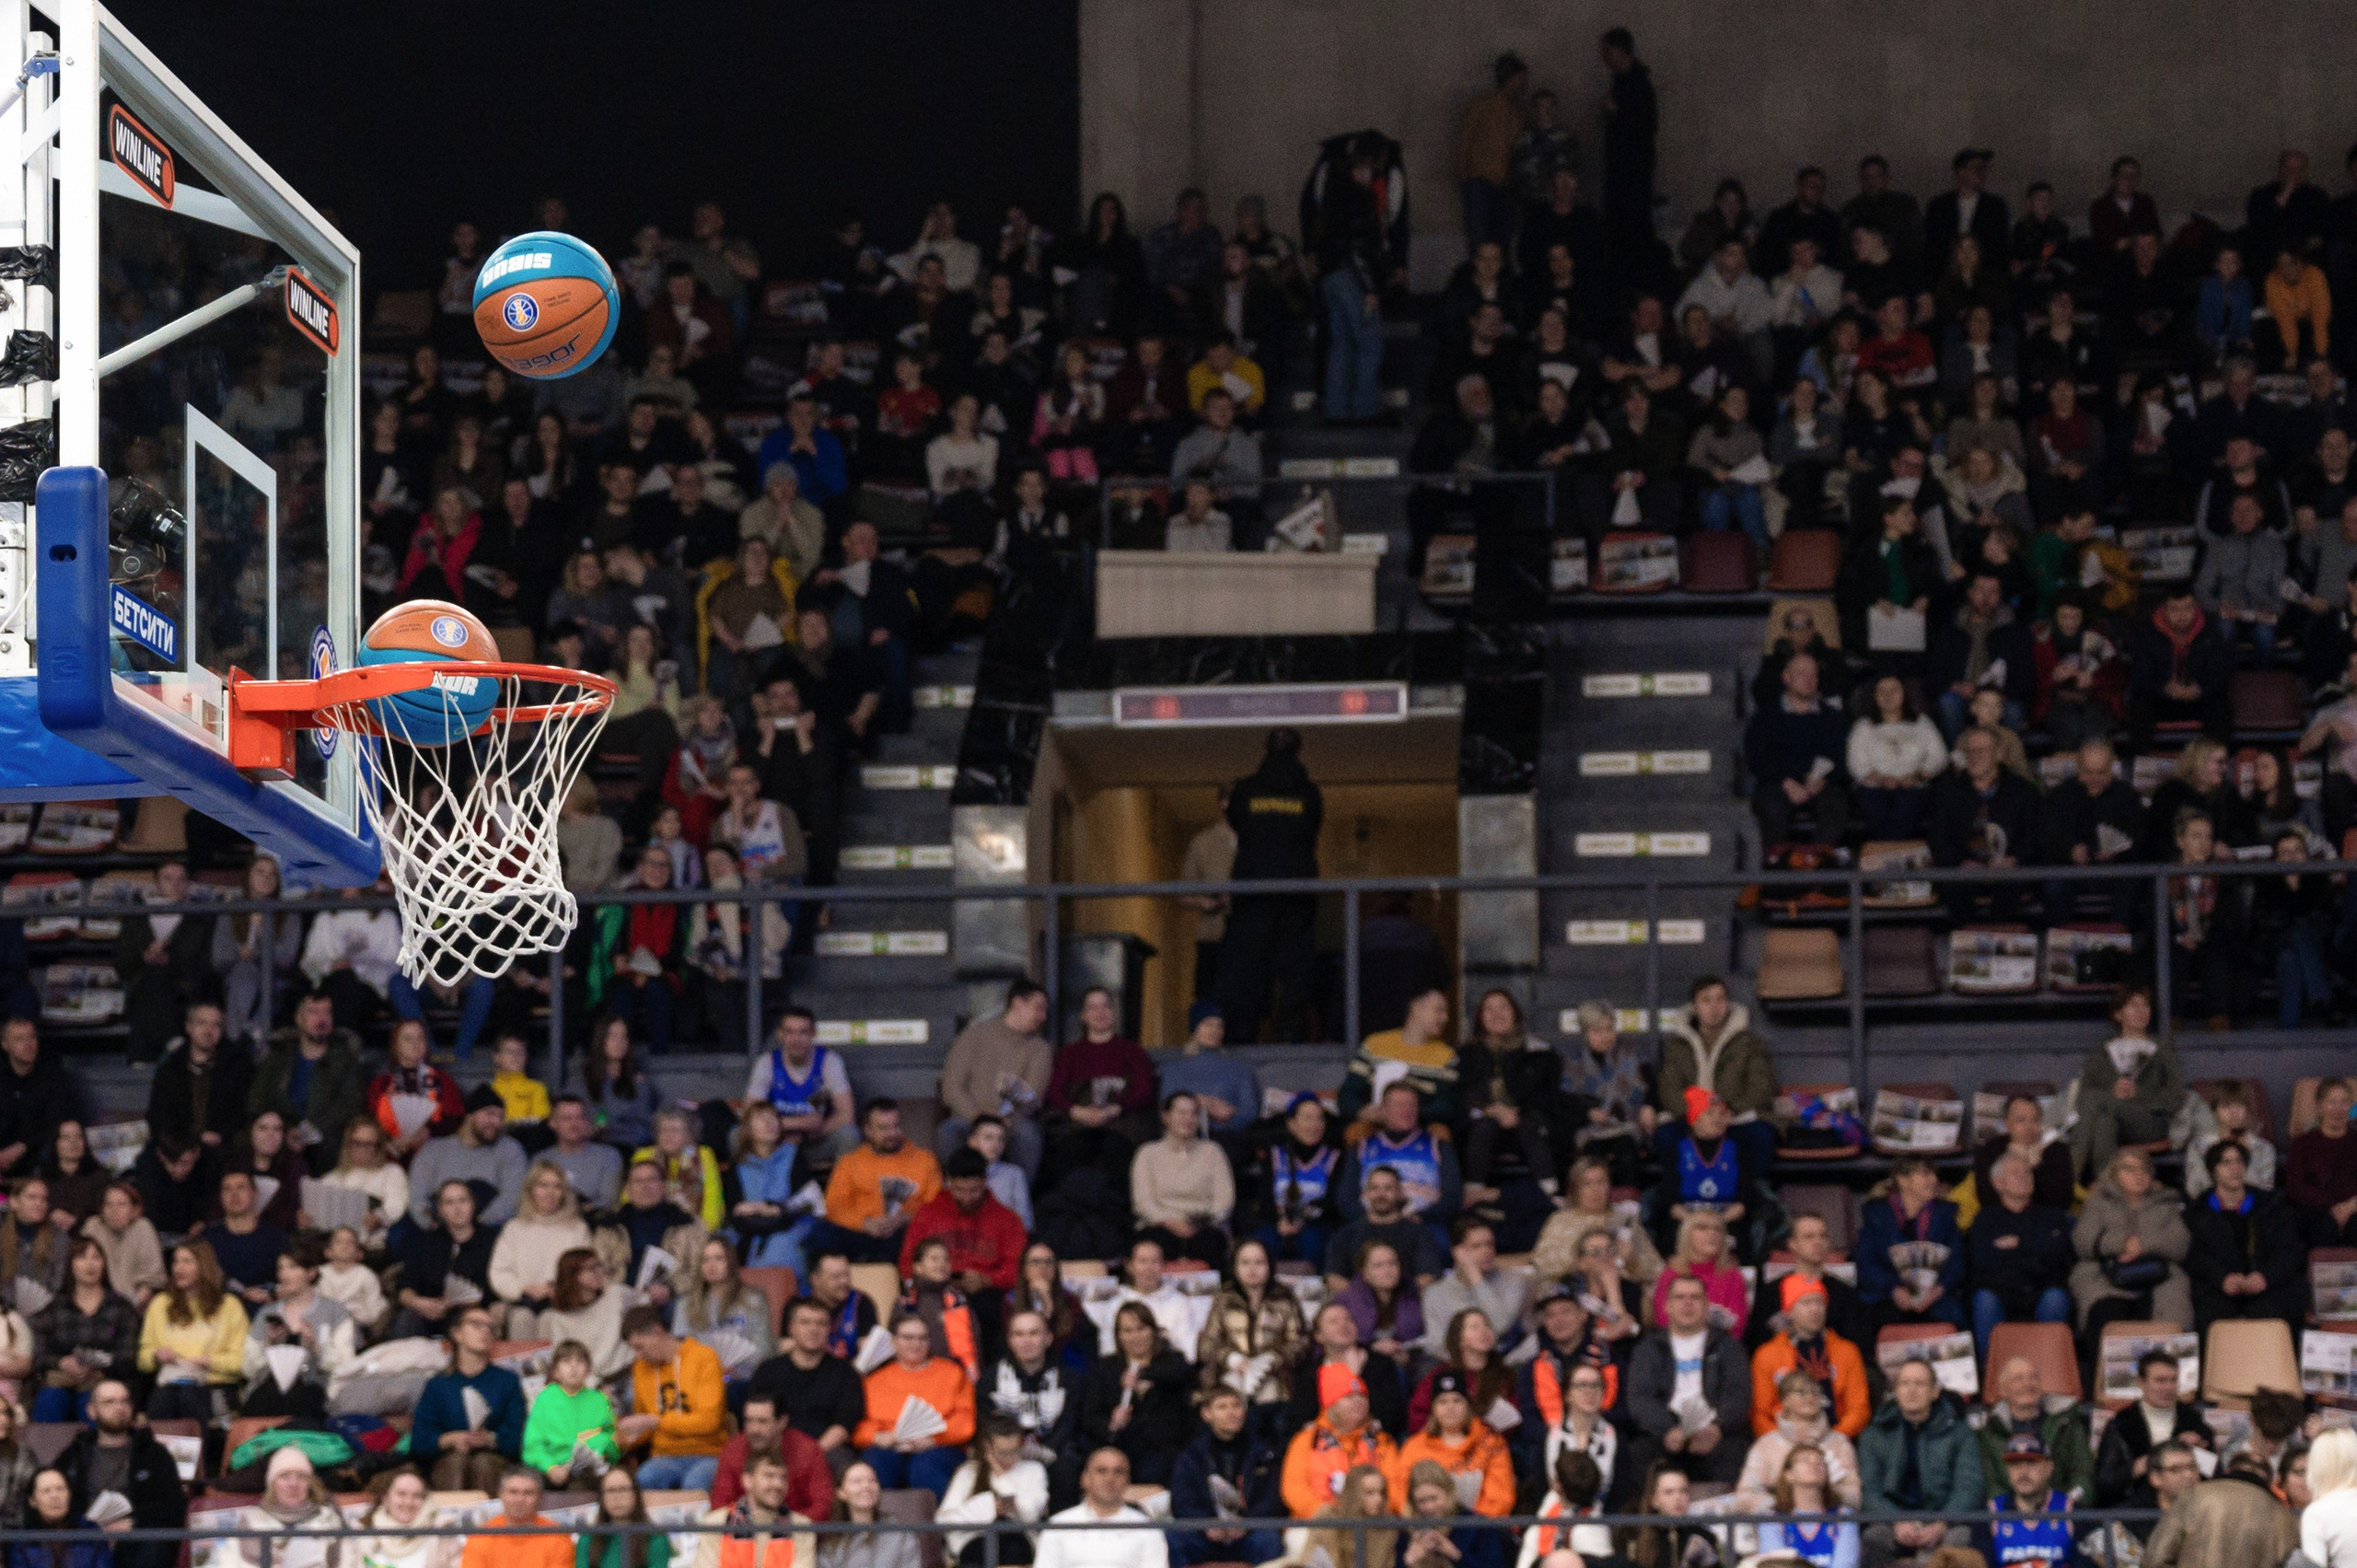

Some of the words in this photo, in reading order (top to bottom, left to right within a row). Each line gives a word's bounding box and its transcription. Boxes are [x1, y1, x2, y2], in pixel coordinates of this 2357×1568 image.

[116, 118, 162, 188] WINLINE
[482, 252, 552, 289] SIBUR
[290, 278, 329, 339] WINLINE
[113, 590, 174, 656] БЕТСИТИ
